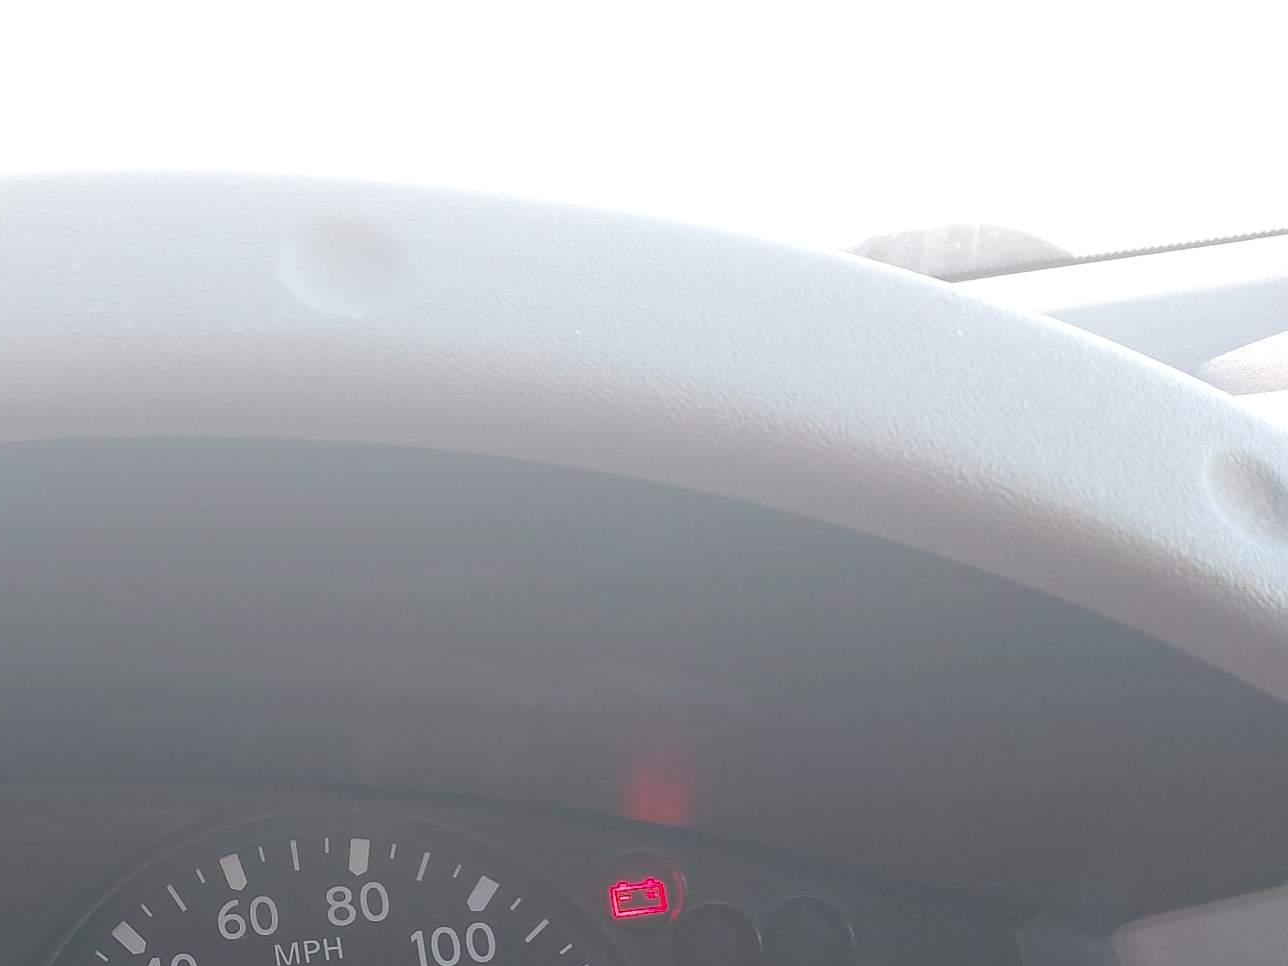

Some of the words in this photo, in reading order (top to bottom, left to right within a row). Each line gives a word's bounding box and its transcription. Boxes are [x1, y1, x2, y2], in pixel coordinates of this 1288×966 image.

[217, 895, 279, 940] 60
[325, 882, 390, 924] 80
[273, 937, 344, 966] MPH
